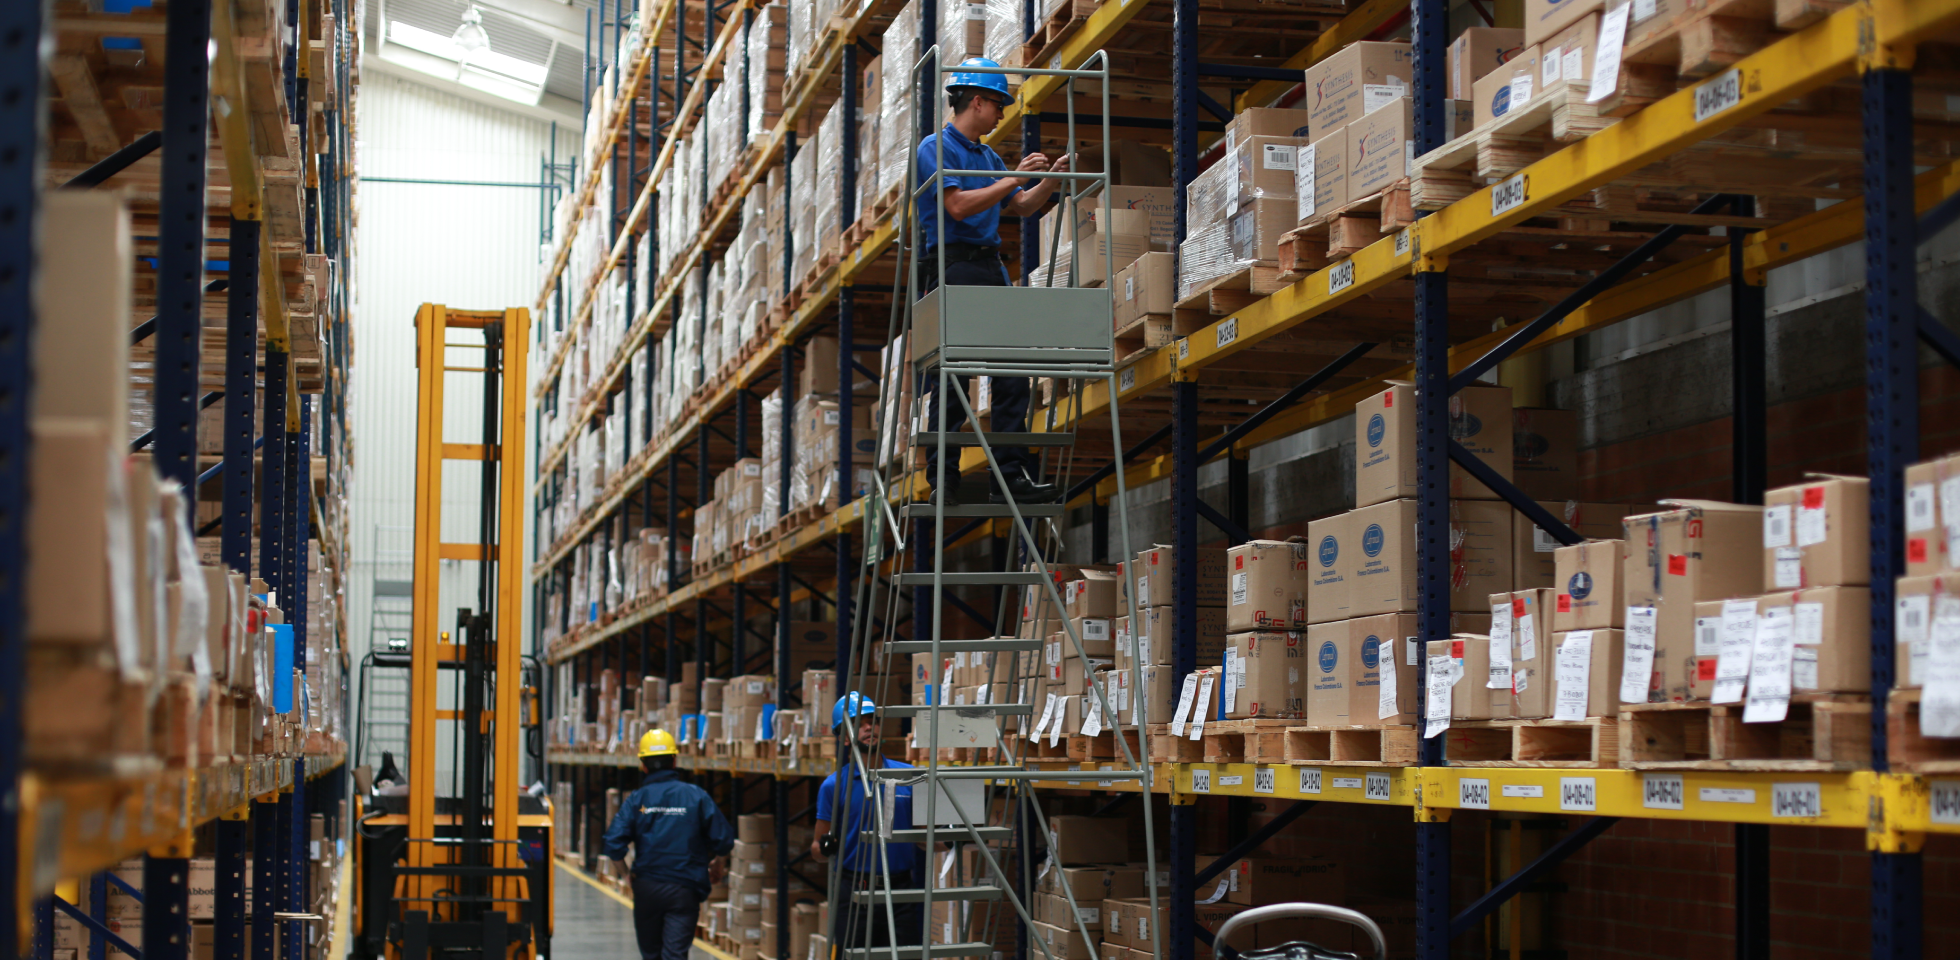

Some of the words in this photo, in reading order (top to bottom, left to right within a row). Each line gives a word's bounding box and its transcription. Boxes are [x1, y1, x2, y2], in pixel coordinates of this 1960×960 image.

[1324, 70, 1354, 92] SYNTHESIS
[1699, 81, 1736, 115] 04-06-03
[1368, 126, 1396, 149] SYNTHESIS
[1494, 181, 1522, 210] 04-08-03
[1331, 264, 1350, 289] 04-10-03
[1255, 772, 1273, 789] 04-12-01
[1301, 773, 1321, 790] 04-10-02
[1367, 777, 1389, 797] 04-10-01
[1462, 784, 1488, 804] 04-08-02
[1563, 784, 1594, 806] 04-08-01
[1646, 781, 1681, 804] 04-06-02
[1776, 790, 1816, 815] 04-06-01
